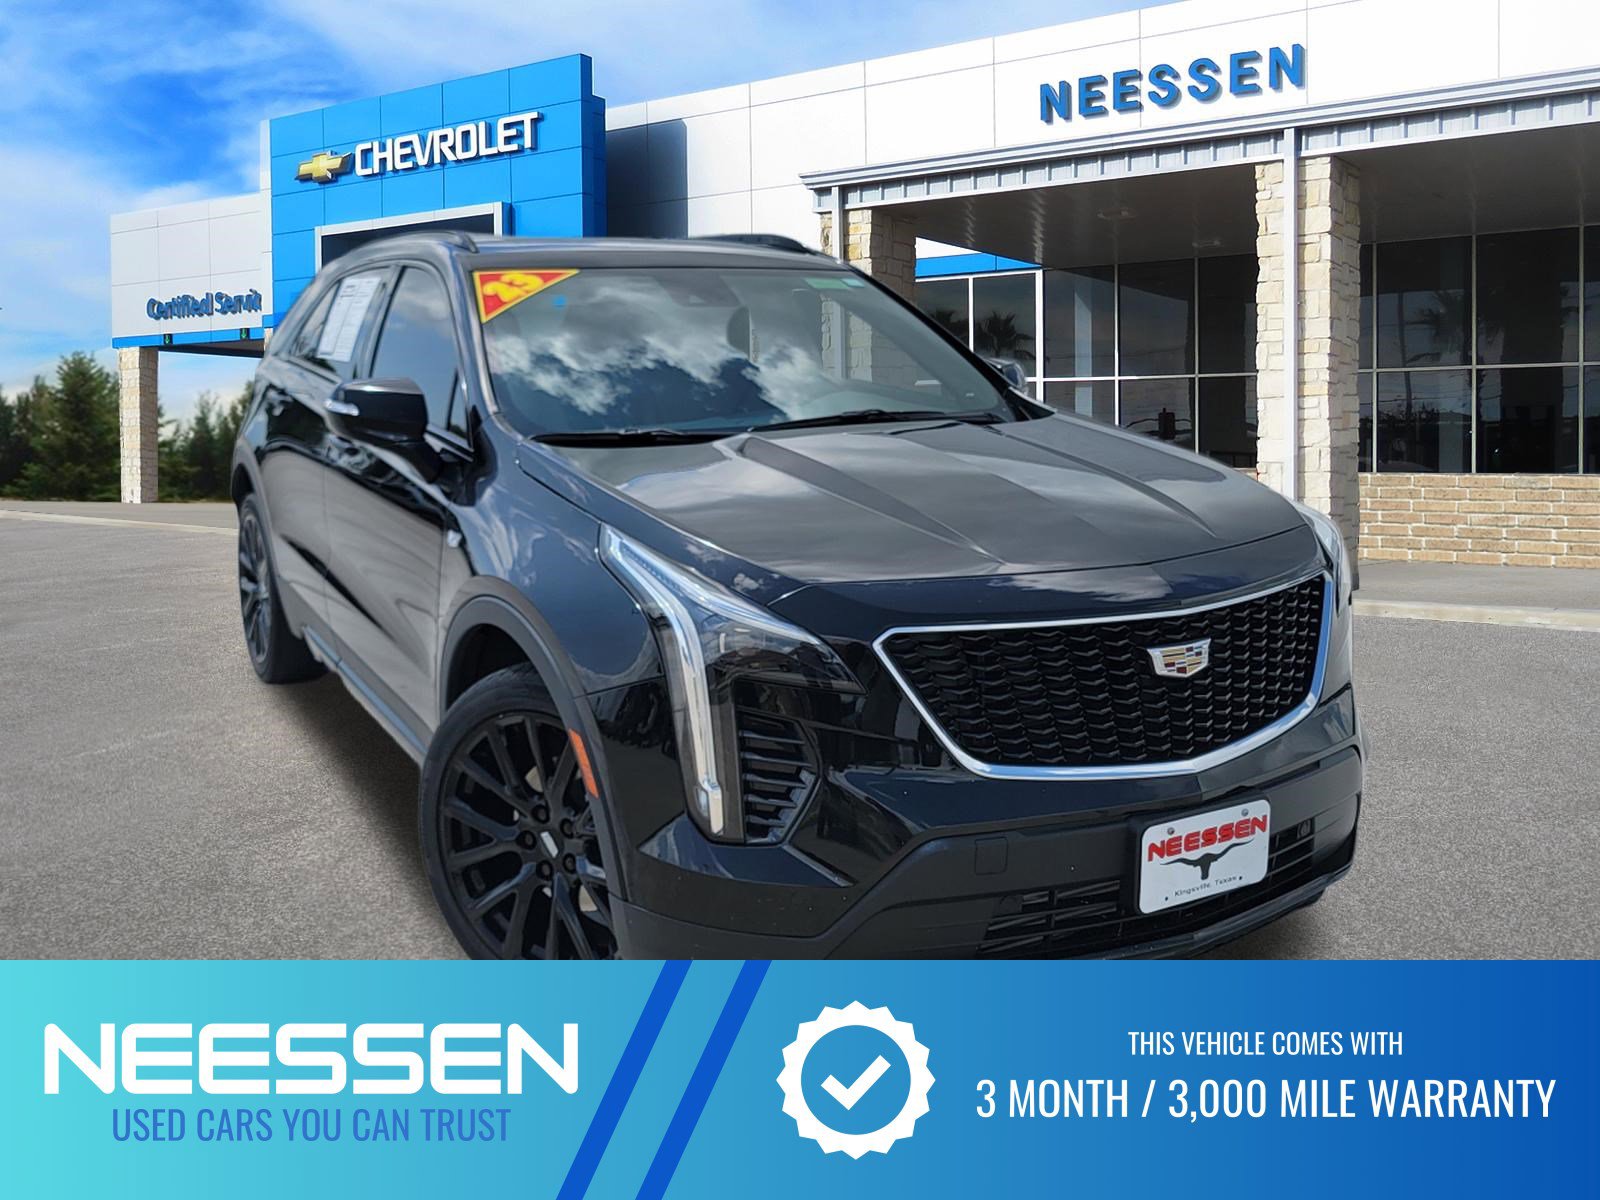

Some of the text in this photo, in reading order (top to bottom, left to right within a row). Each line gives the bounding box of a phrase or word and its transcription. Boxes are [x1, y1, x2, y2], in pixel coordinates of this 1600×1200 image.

[1040, 43, 1305, 124] NEESSEN
[354, 111, 544, 177] CHEVROLET
[146, 292, 214, 320] Certified
[1147, 815, 1268, 862] NEESSEN
[1215, 875, 1238, 887] Texas
